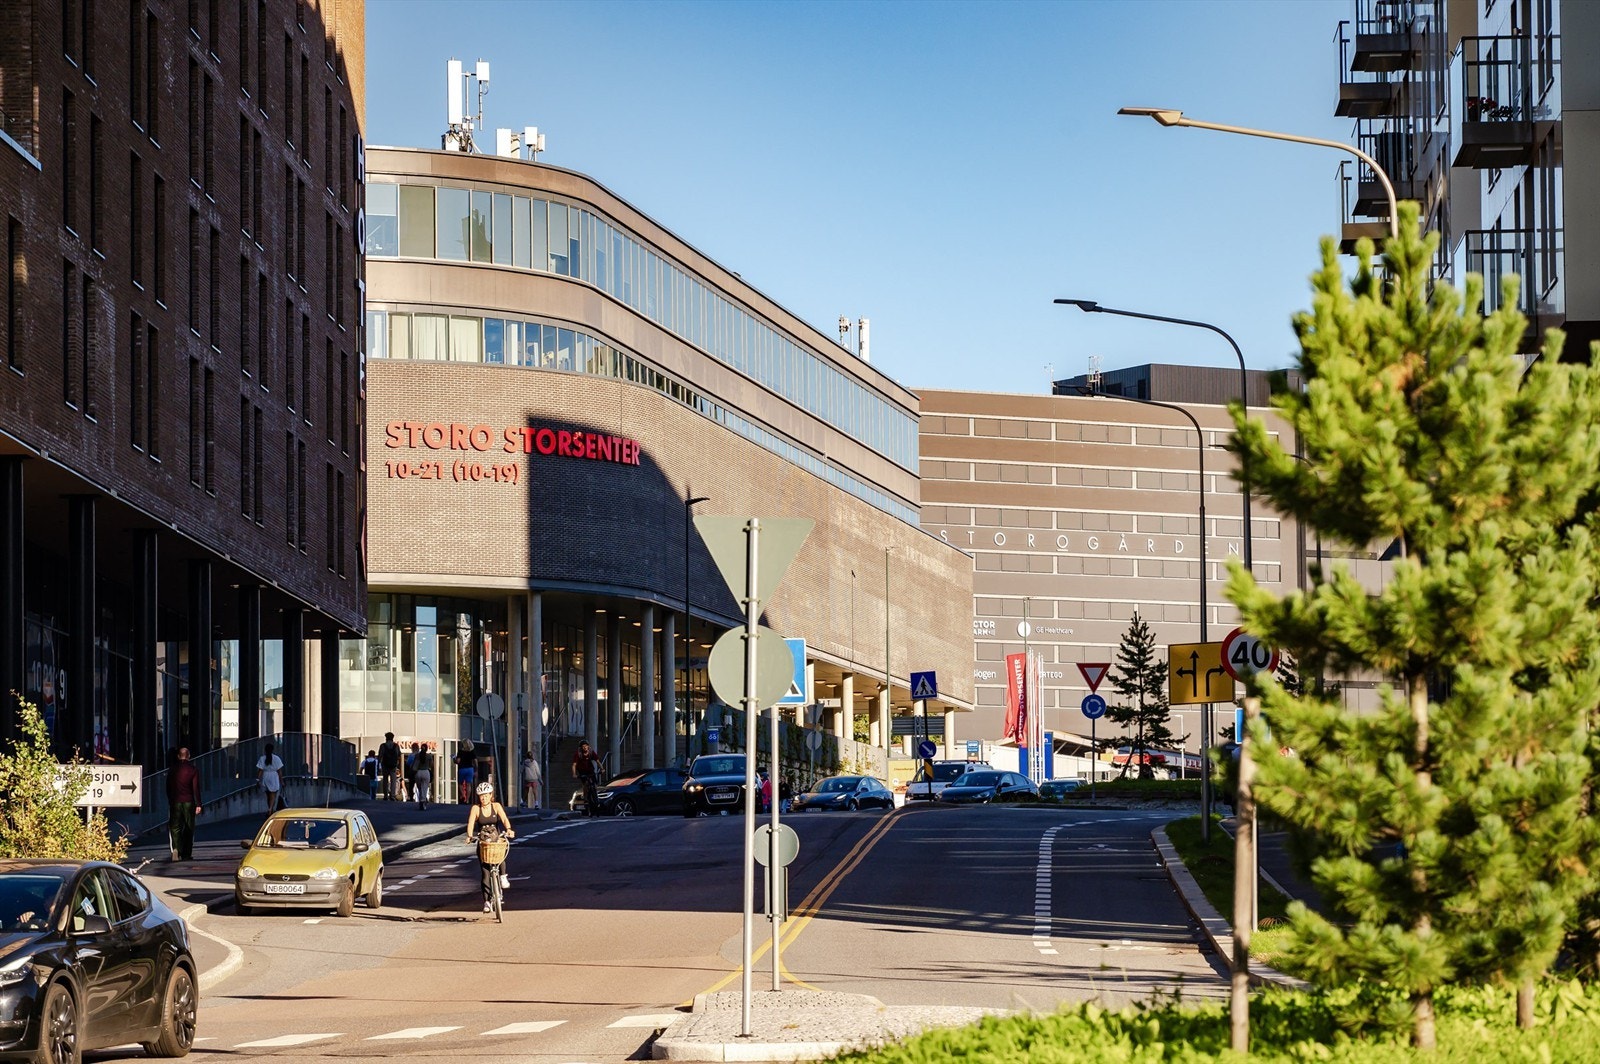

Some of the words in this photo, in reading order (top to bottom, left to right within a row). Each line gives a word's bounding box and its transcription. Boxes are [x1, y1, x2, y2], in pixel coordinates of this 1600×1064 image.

[355, 133, 366, 471] HOTEL
[385, 421, 494, 451] STORO
[503, 426, 641, 466] STORSENTER
[385, 459, 443, 479] 10-21
[452, 459, 519, 484] (10-19)
[973, 620, 995, 629] CTOR
[1231, 640, 1270, 669] 40
